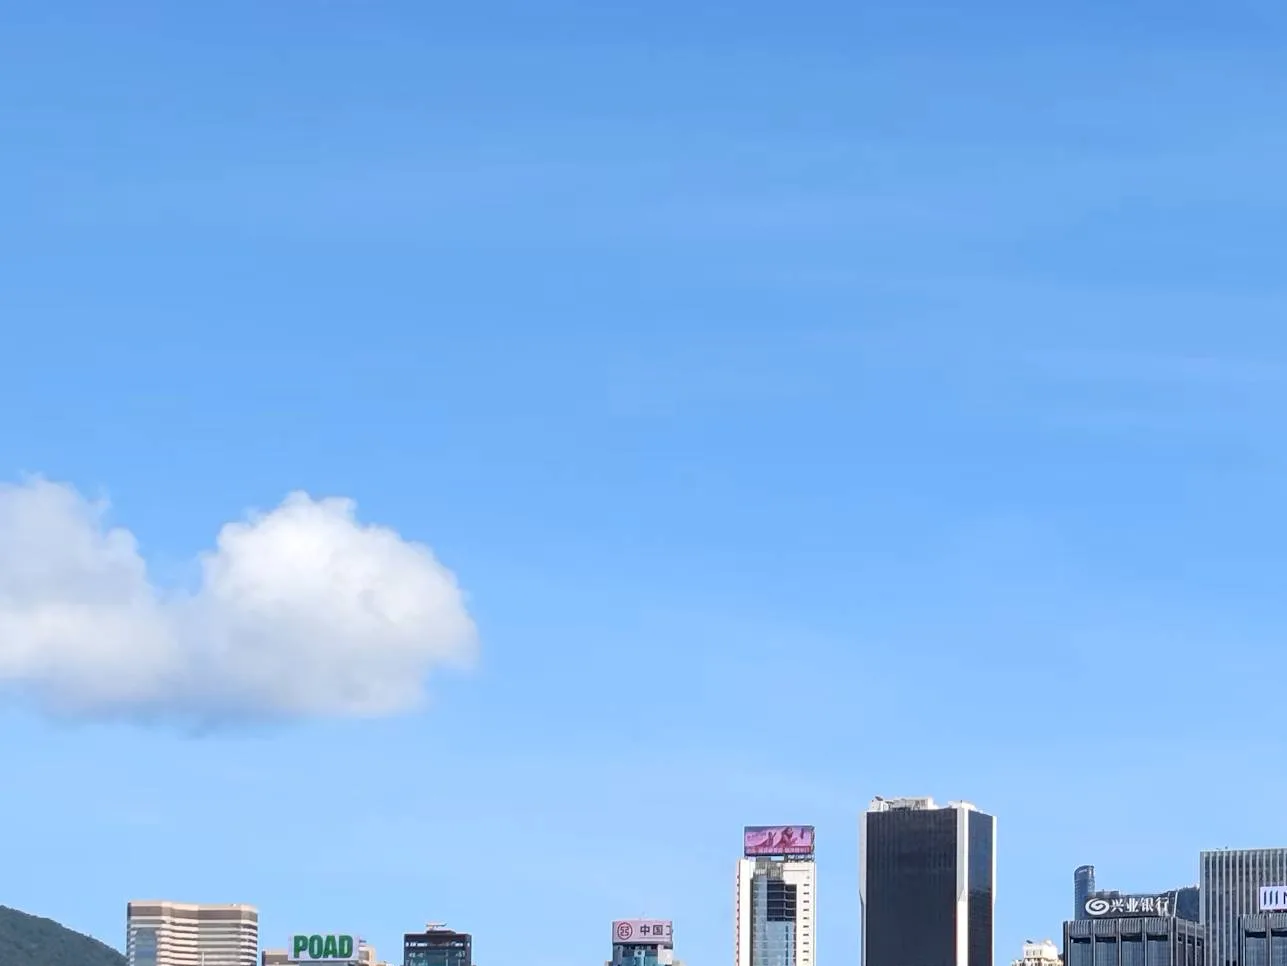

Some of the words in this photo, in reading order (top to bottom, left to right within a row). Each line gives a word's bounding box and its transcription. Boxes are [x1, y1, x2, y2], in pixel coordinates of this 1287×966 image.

[1110, 897, 1170, 917] 兴业银行
[293, 934, 354, 960] POAD
